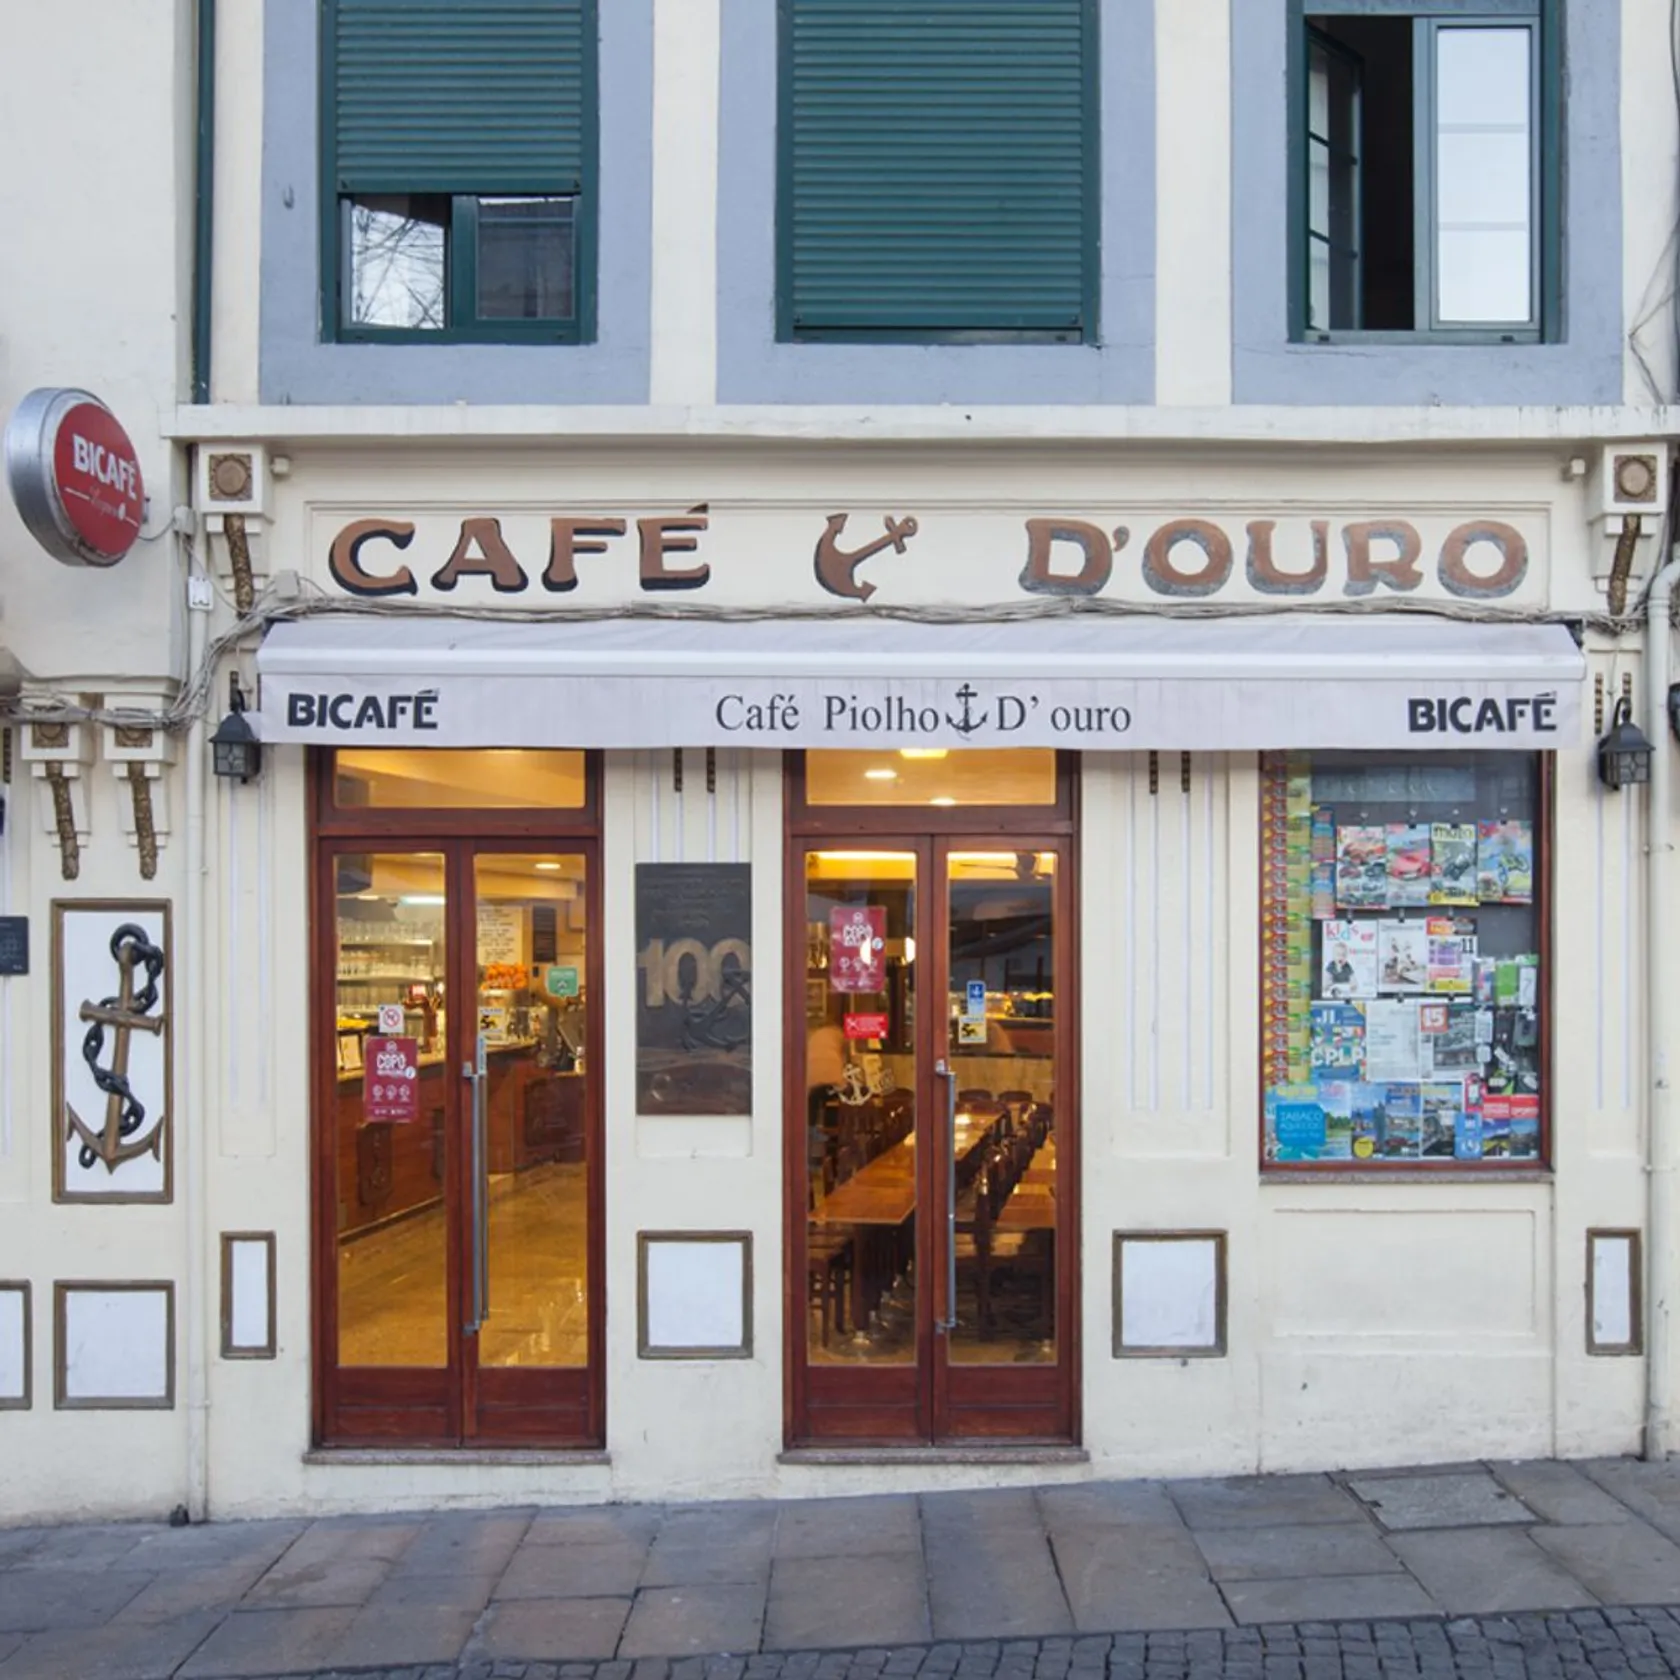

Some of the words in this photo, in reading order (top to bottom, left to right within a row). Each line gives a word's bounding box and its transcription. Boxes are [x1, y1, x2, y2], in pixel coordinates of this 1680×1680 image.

[72, 432, 138, 501] BICAFÉ
[328, 503, 712, 597] CAFÉ
[1018, 517, 1530, 598] D'OURO
[287, 688, 440, 731] BICAFÉ
[715, 694, 800, 731] Café
[823, 694, 940, 732] Piolho
[1050, 705, 1132, 732] ouro
[1407, 691, 1558, 734] BICAFÉ
[636, 937, 751, 1008] 100
